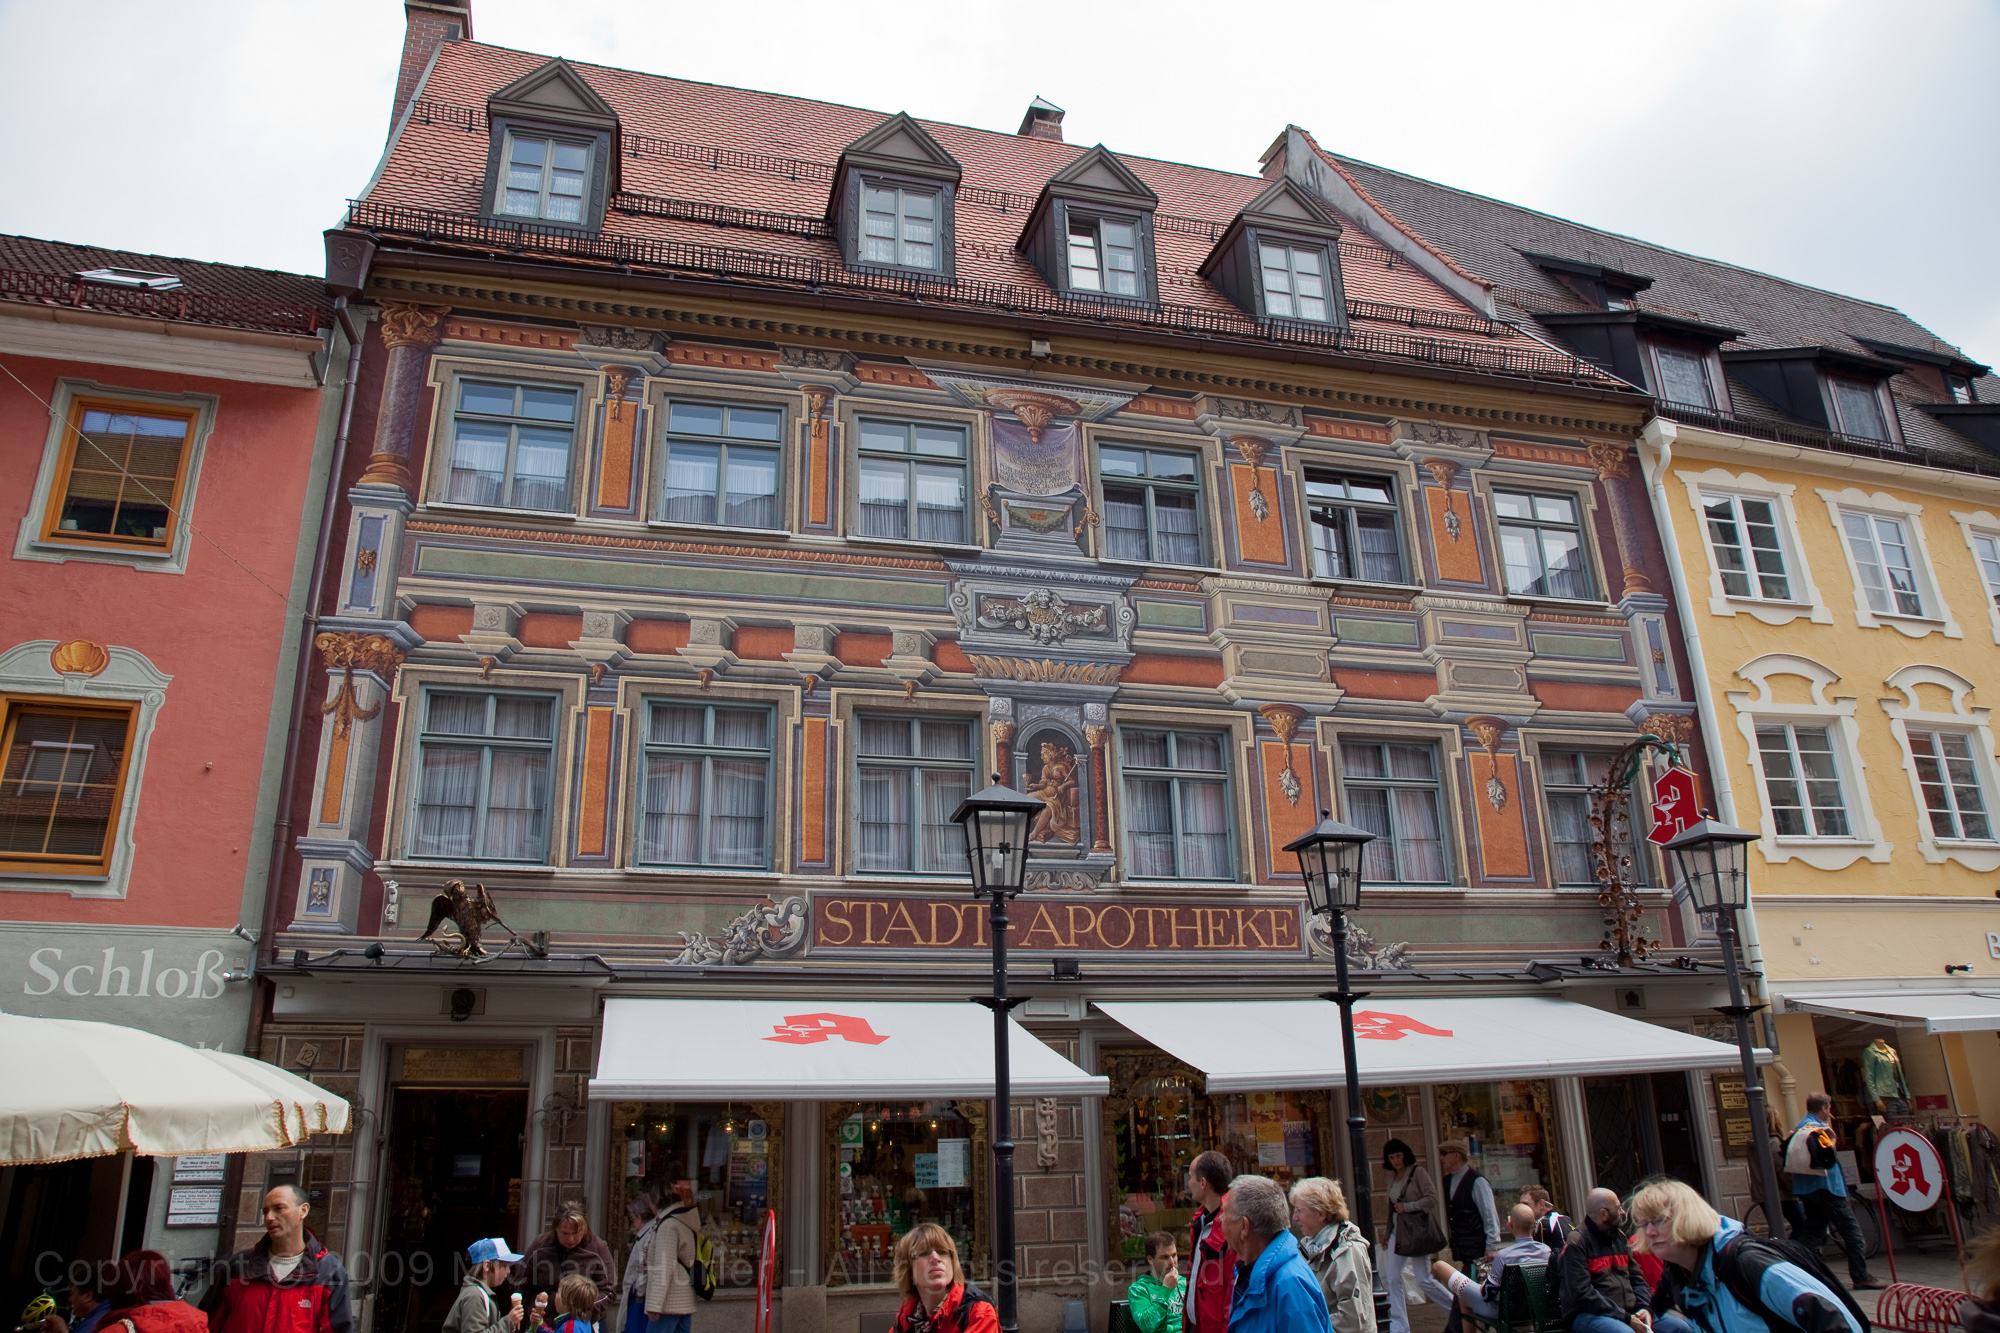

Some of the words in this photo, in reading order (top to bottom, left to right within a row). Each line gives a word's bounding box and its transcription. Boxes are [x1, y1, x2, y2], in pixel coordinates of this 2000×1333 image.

[818, 900, 1298, 949] STADT-APOTHEKE
[23, 946, 226, 1000] Schloß
[300, 1048, 315, 1064] 12
